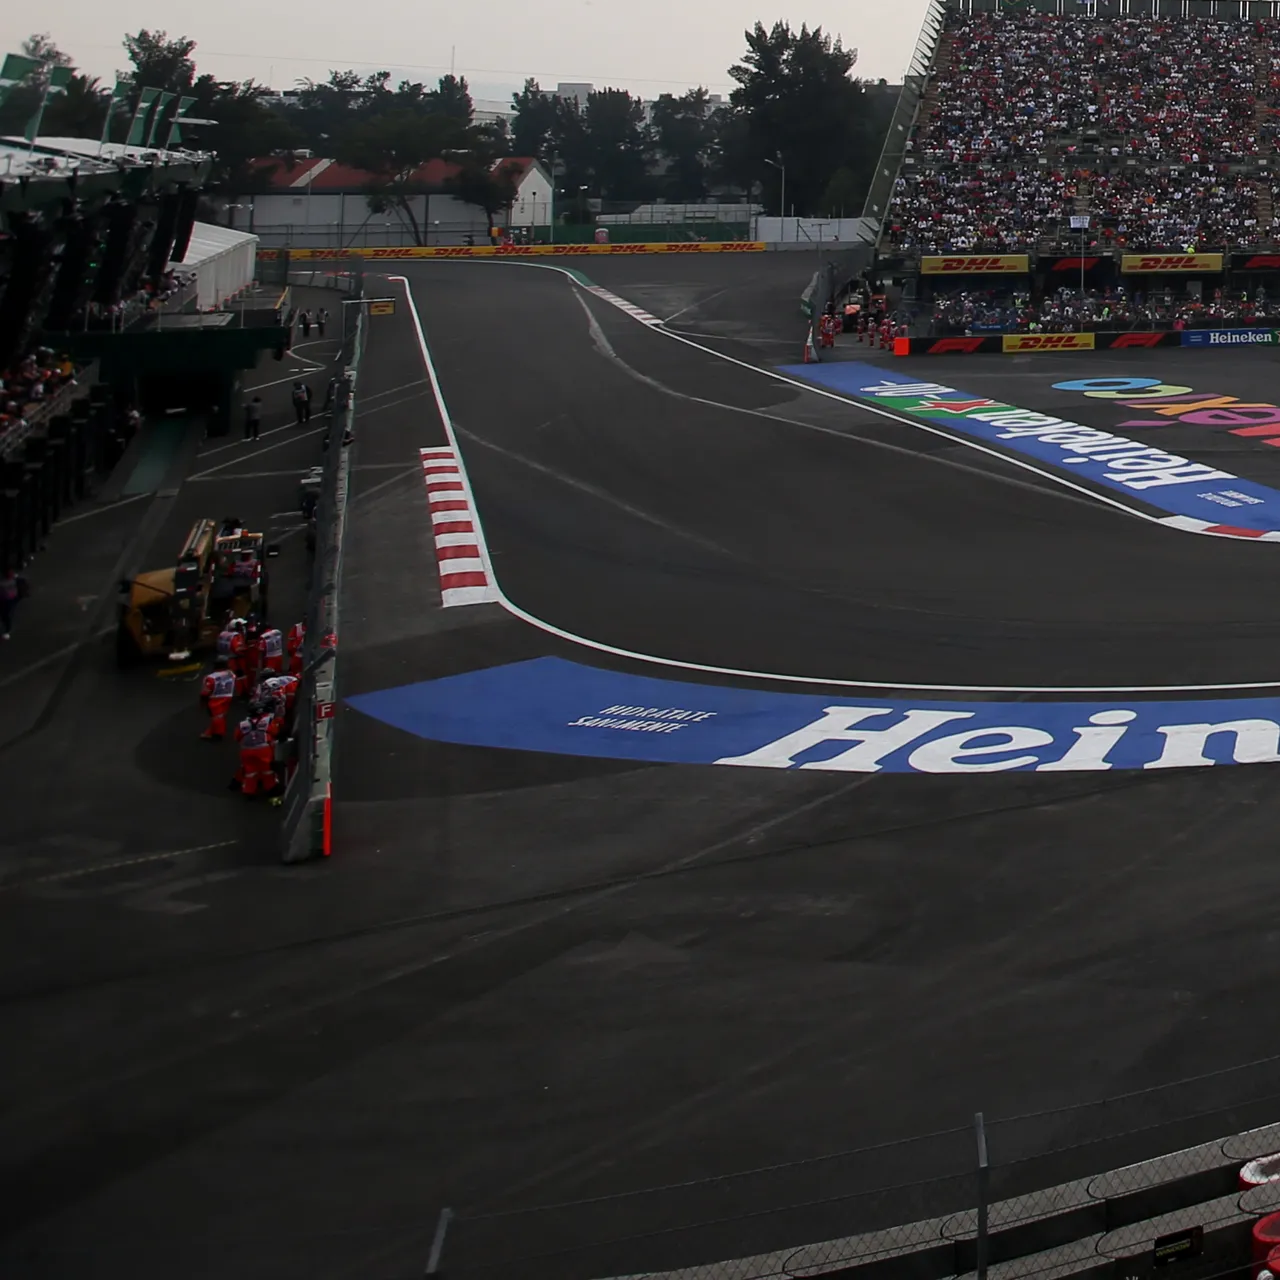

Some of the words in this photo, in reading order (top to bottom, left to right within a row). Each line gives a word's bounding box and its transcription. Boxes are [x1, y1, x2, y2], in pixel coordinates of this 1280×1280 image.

[373, 248, 413, 257] DHL
[433, 248, 473, 256] DHL
[553, 245, 590, 254] DHL
[611, 244, 647, 253] DHL
[666, 244, 702, 252] DHL
[719, 243, 755, 251] DHL
[941, 258, 1005, 270] DHL
[1139, 257, 1200, 269] DHL
[1018, 336, 1077, 349] DHL
[1209, 331, 1272, 344] Heineken
[973, 407, 1239, 490] Heineken
[321, 704, 332, 718] F
[567, 716, 689, 733] SANAMENTE
